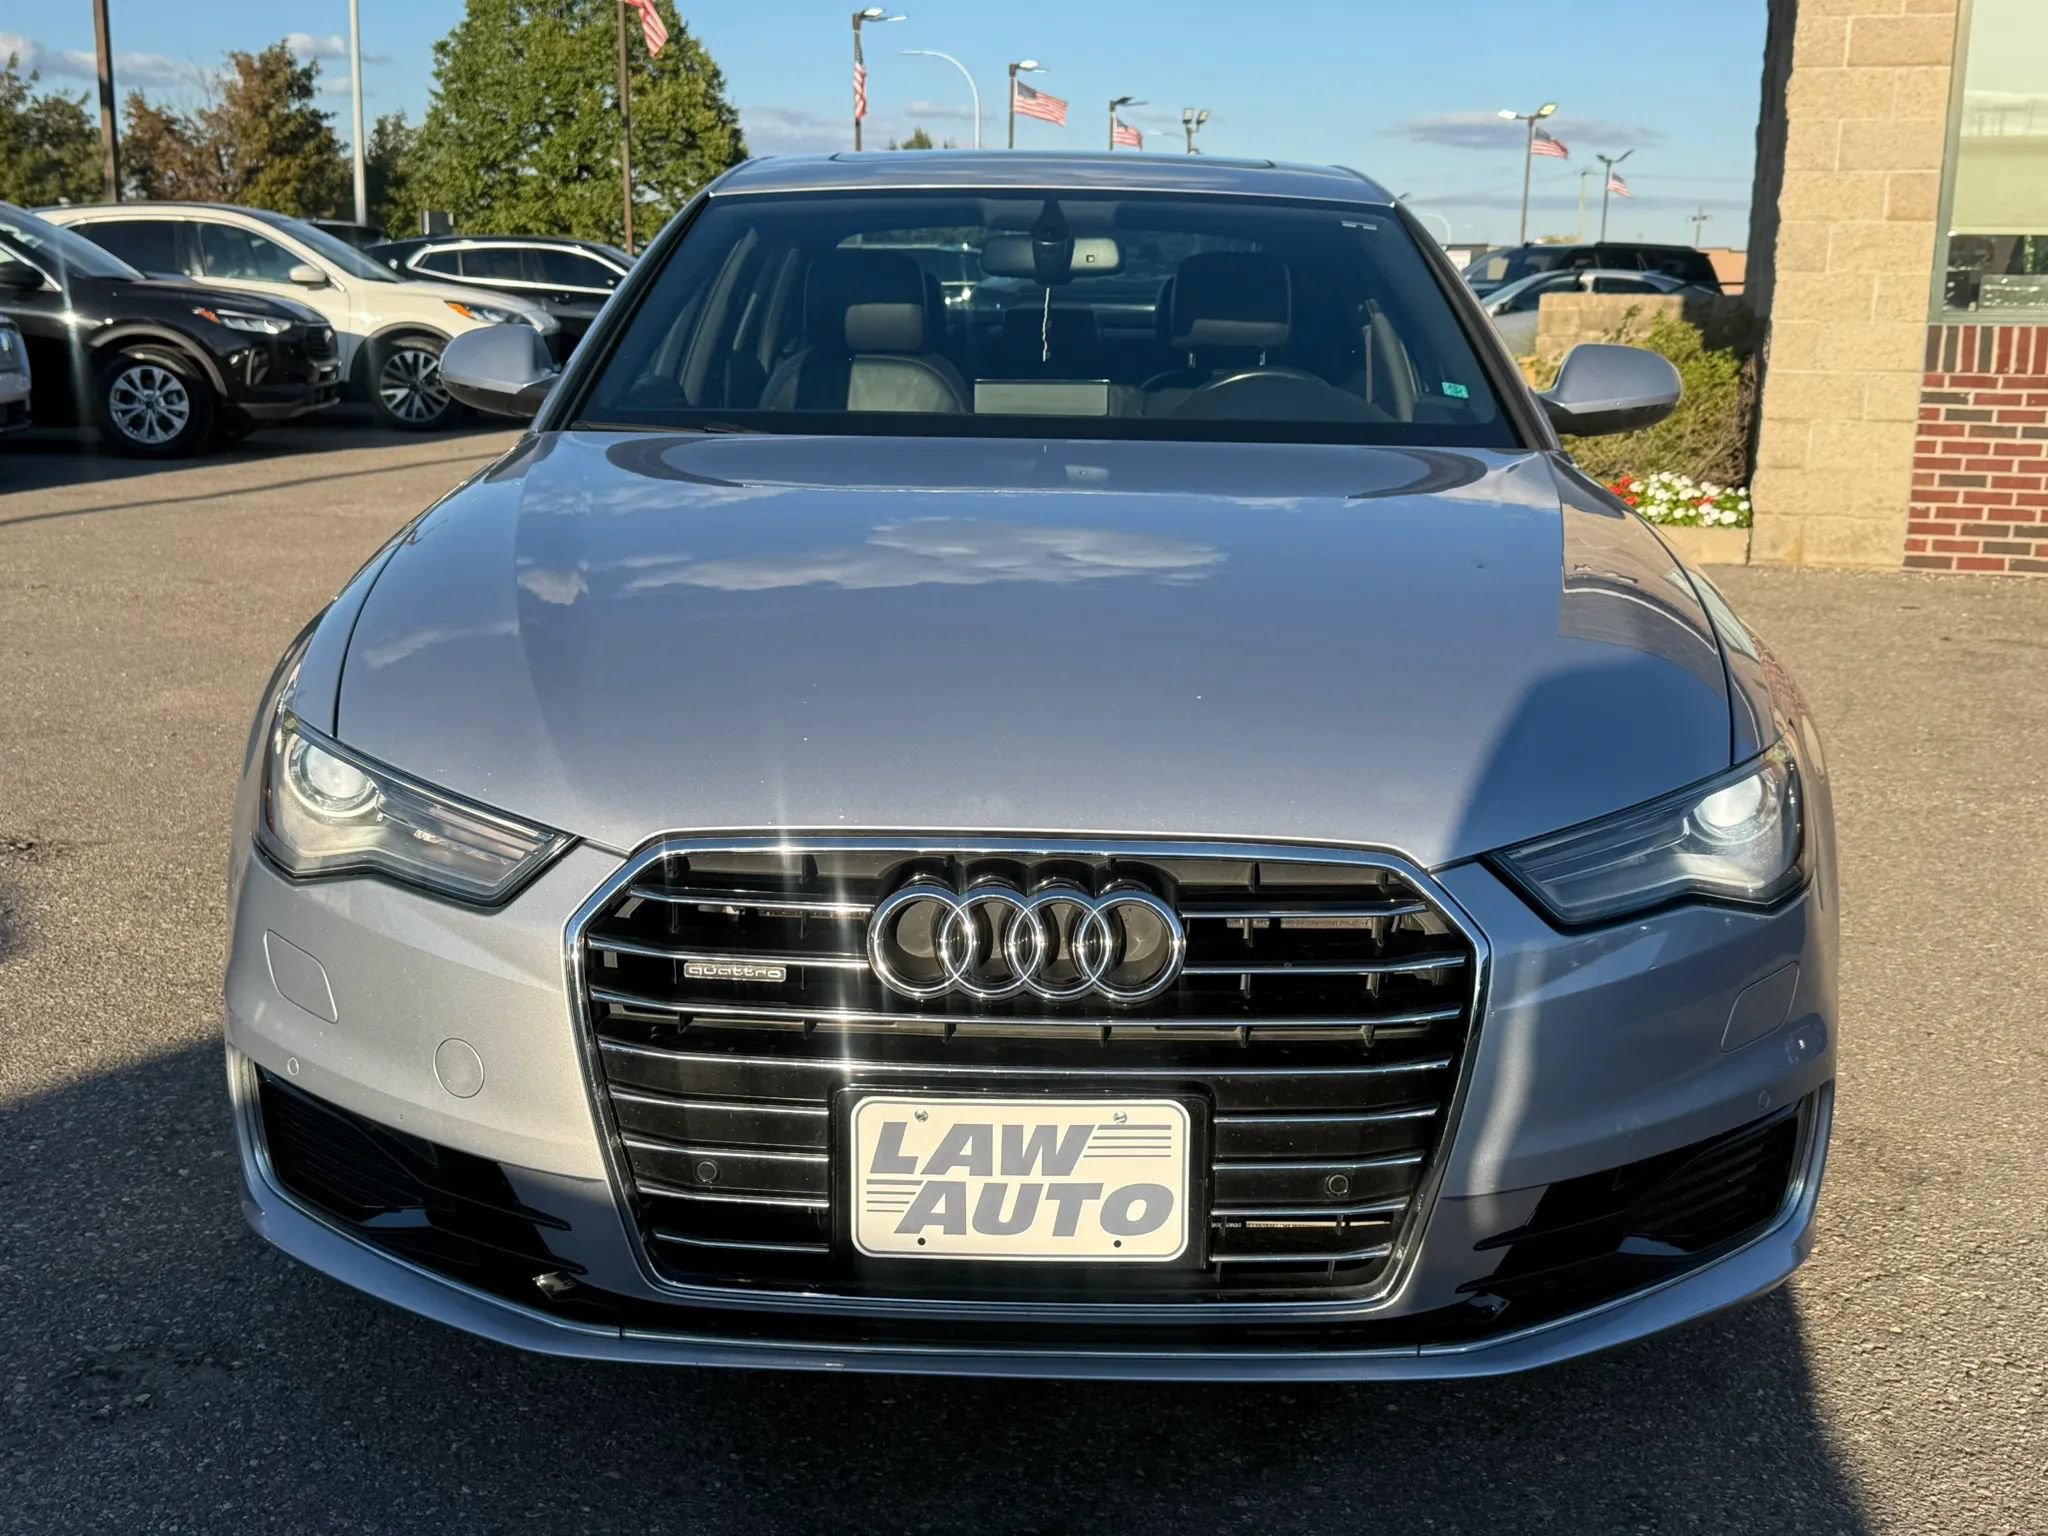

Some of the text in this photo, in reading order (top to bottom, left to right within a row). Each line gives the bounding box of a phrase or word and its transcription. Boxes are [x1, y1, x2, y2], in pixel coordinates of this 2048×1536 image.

[688, 964, 782, 979] quattro
[870, 1122, 1096, 1177] LAW
[893, 1180, 1175, 1237] AUTO
